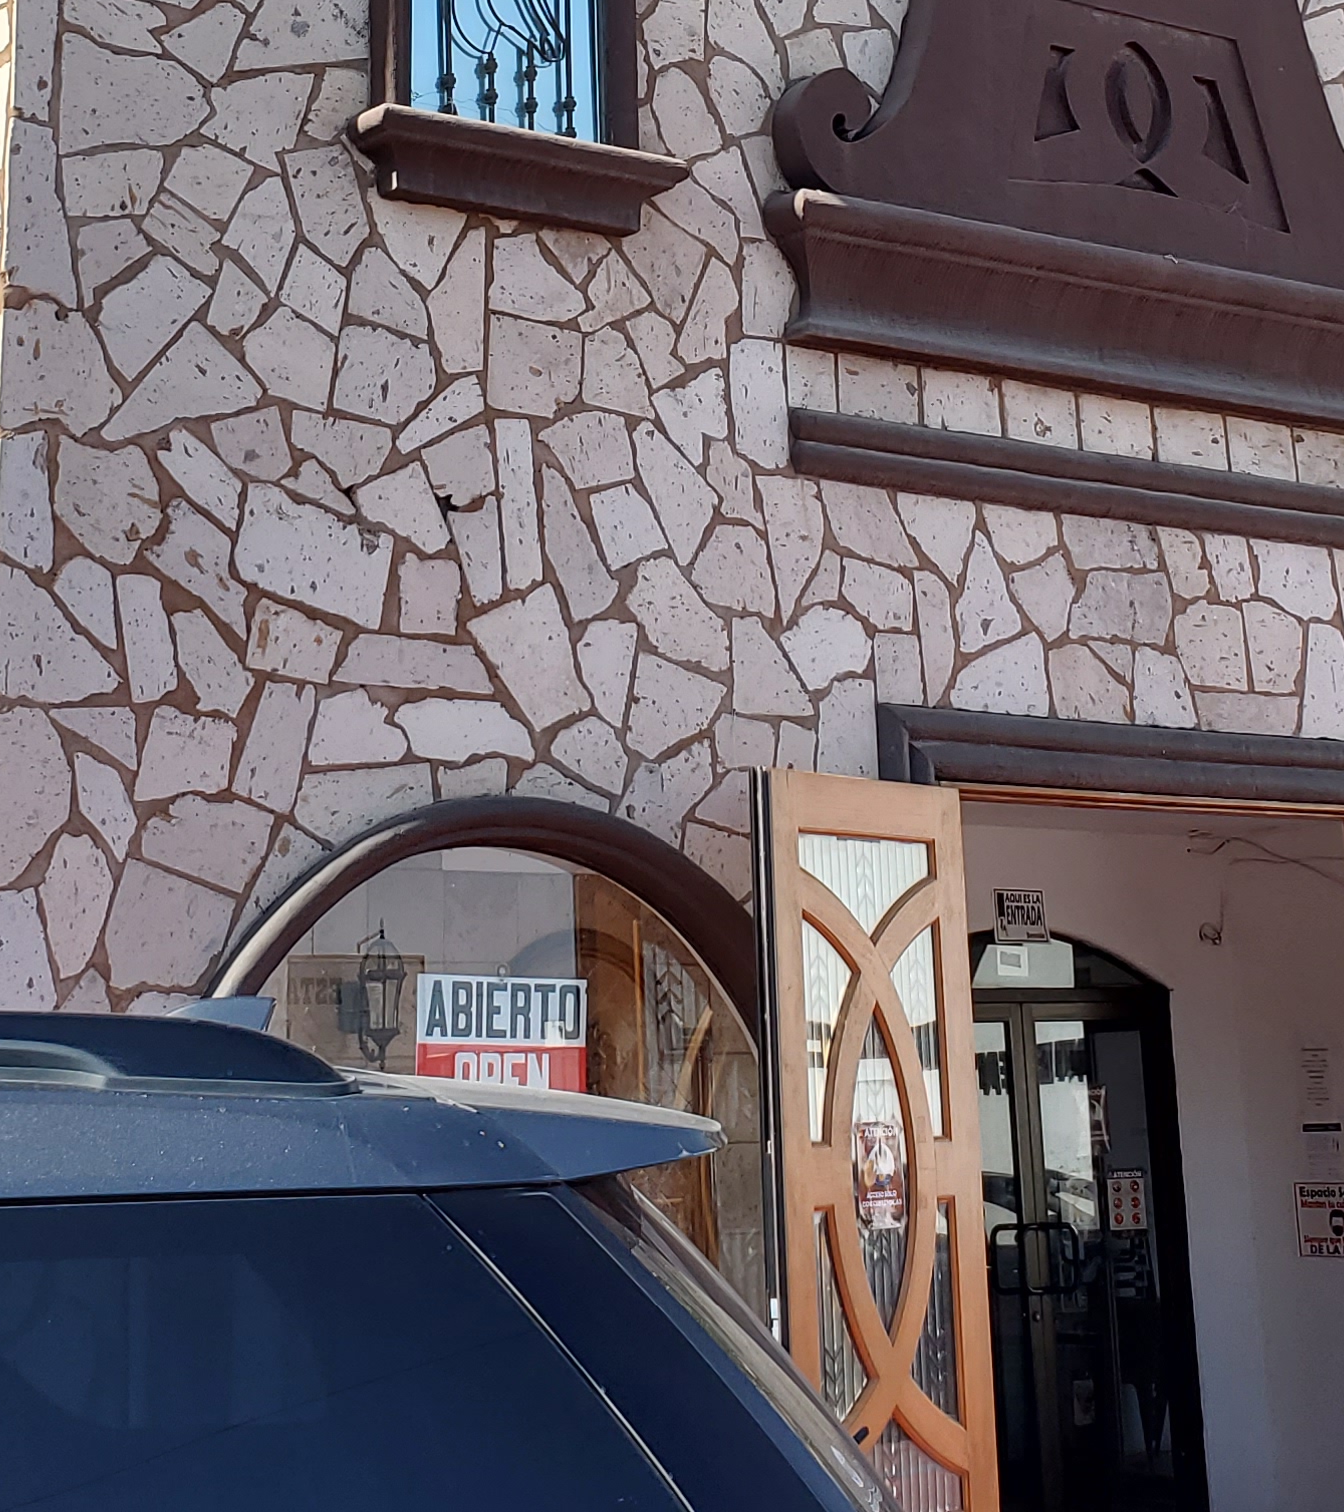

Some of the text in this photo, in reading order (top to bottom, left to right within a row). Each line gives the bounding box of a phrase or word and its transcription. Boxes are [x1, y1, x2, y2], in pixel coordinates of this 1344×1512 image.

[1023, 893, 1031, 904] ES
[1032, 894, 1041, 904] LA
[1006, 904, 1043, 927] ENTRADA
[425, 979, 580, 1040] ABIERTO
[1298, 1186, 1336, 1199] Espacio
[1310, 1244, 1325, 1255] DE
[1326, 1245, 1341, 1255] LA
